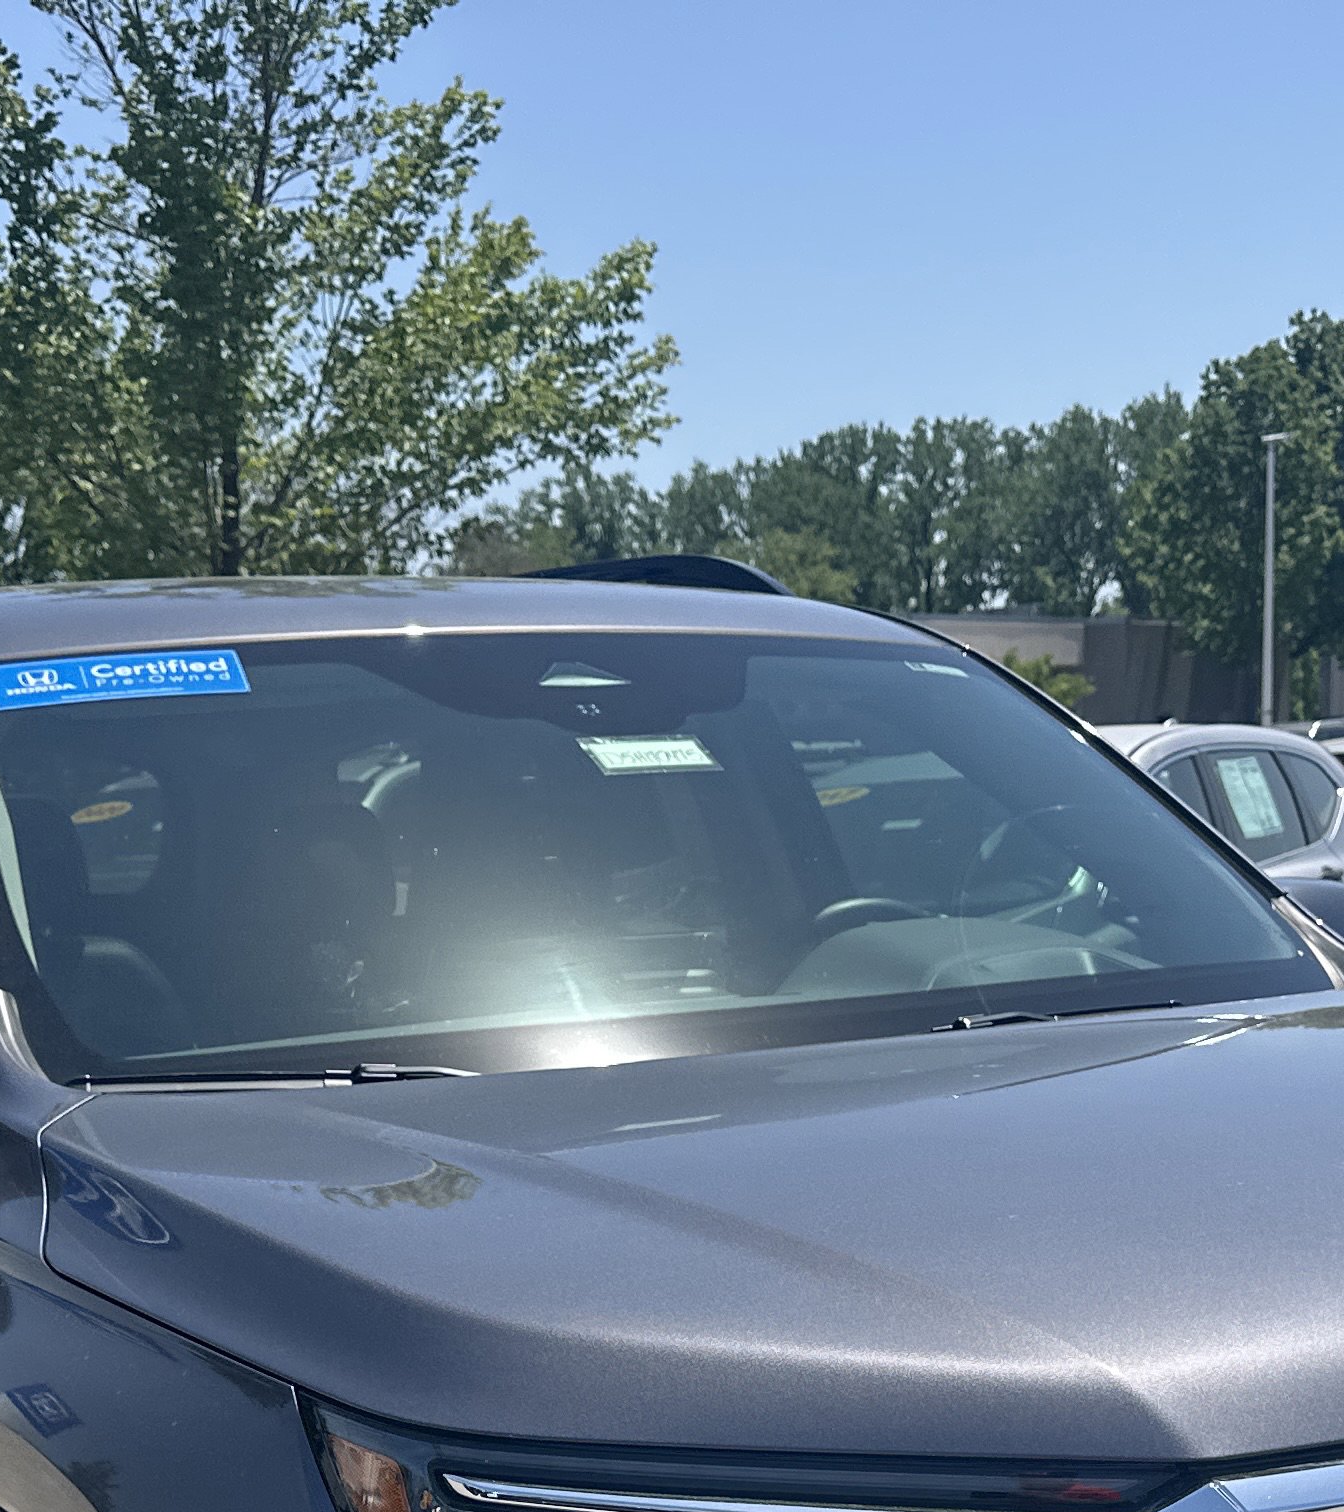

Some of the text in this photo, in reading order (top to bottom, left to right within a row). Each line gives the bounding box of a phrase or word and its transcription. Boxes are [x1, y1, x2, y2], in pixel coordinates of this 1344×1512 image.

[90, 657, 228, 679] Certified
[95, 671, 231, 687] Pre-Owned
[7, 682, 77, 696] HONDA
